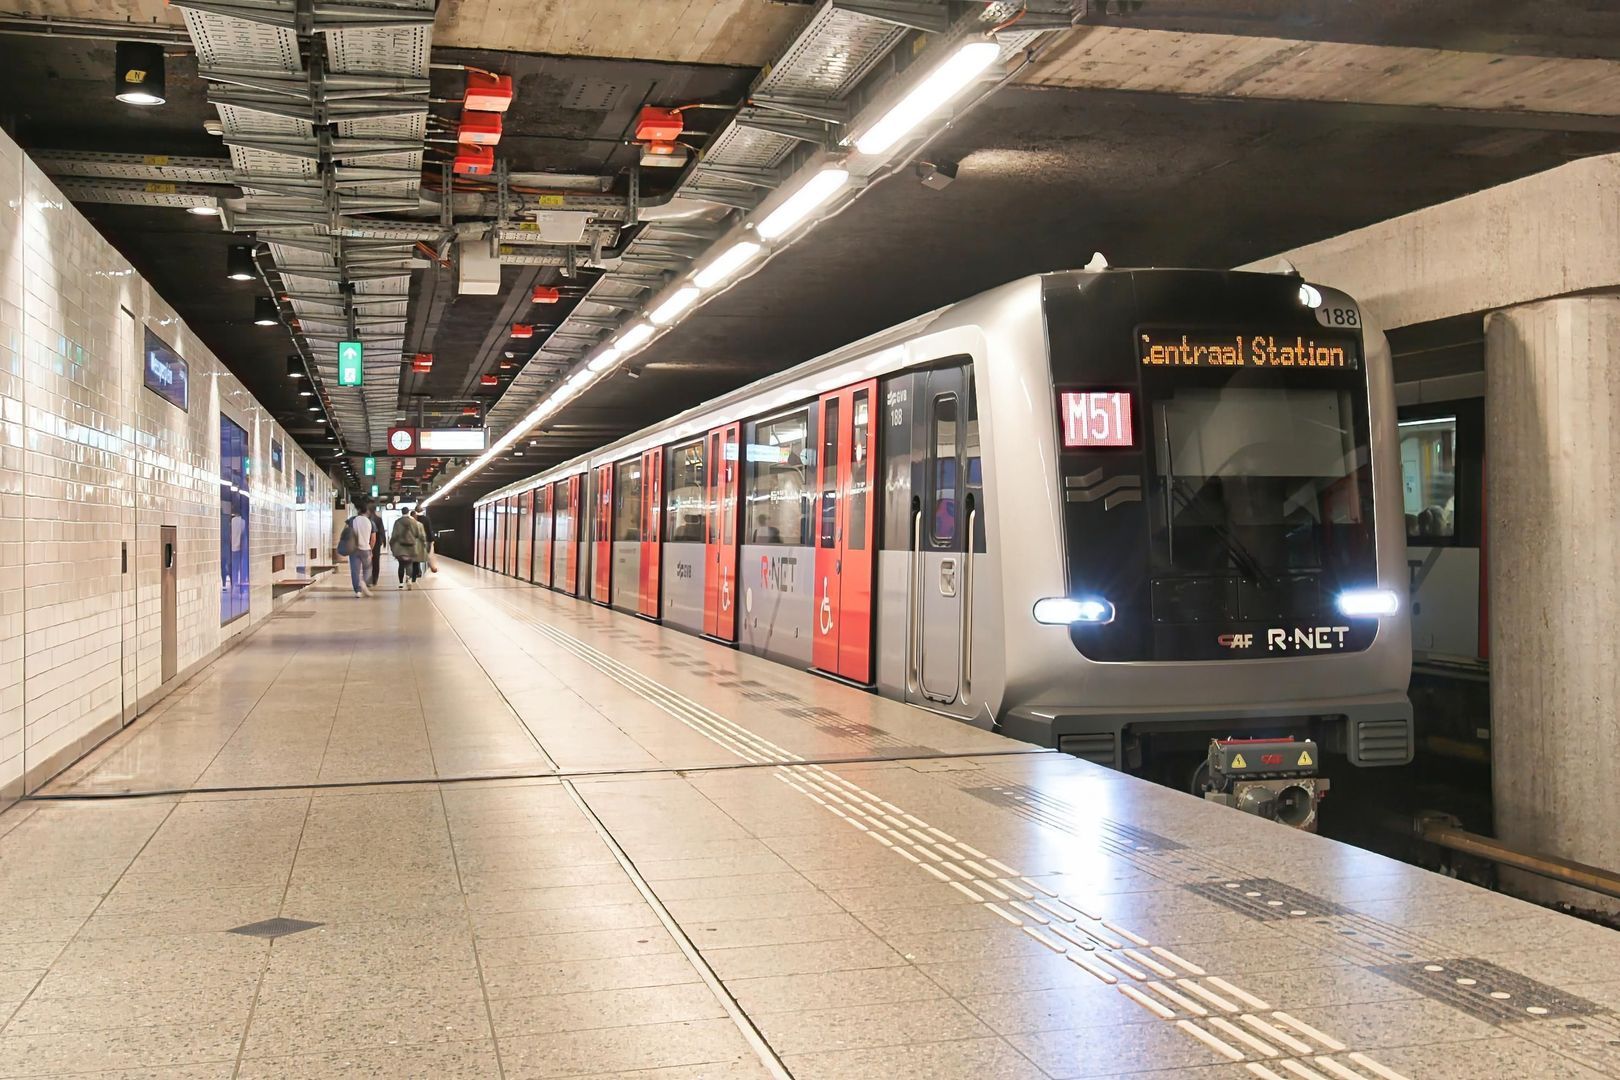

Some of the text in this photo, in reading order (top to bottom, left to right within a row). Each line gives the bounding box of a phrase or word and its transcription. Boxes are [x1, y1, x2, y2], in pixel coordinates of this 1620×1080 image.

[1322, 307, 1357, 326] 188
[1251, 335, 1344, 366] Station
[891, 408, 903, 427] 188
[1068, 392, 1122, 440] M51
[1217, 633, 1254, 649] CAF
